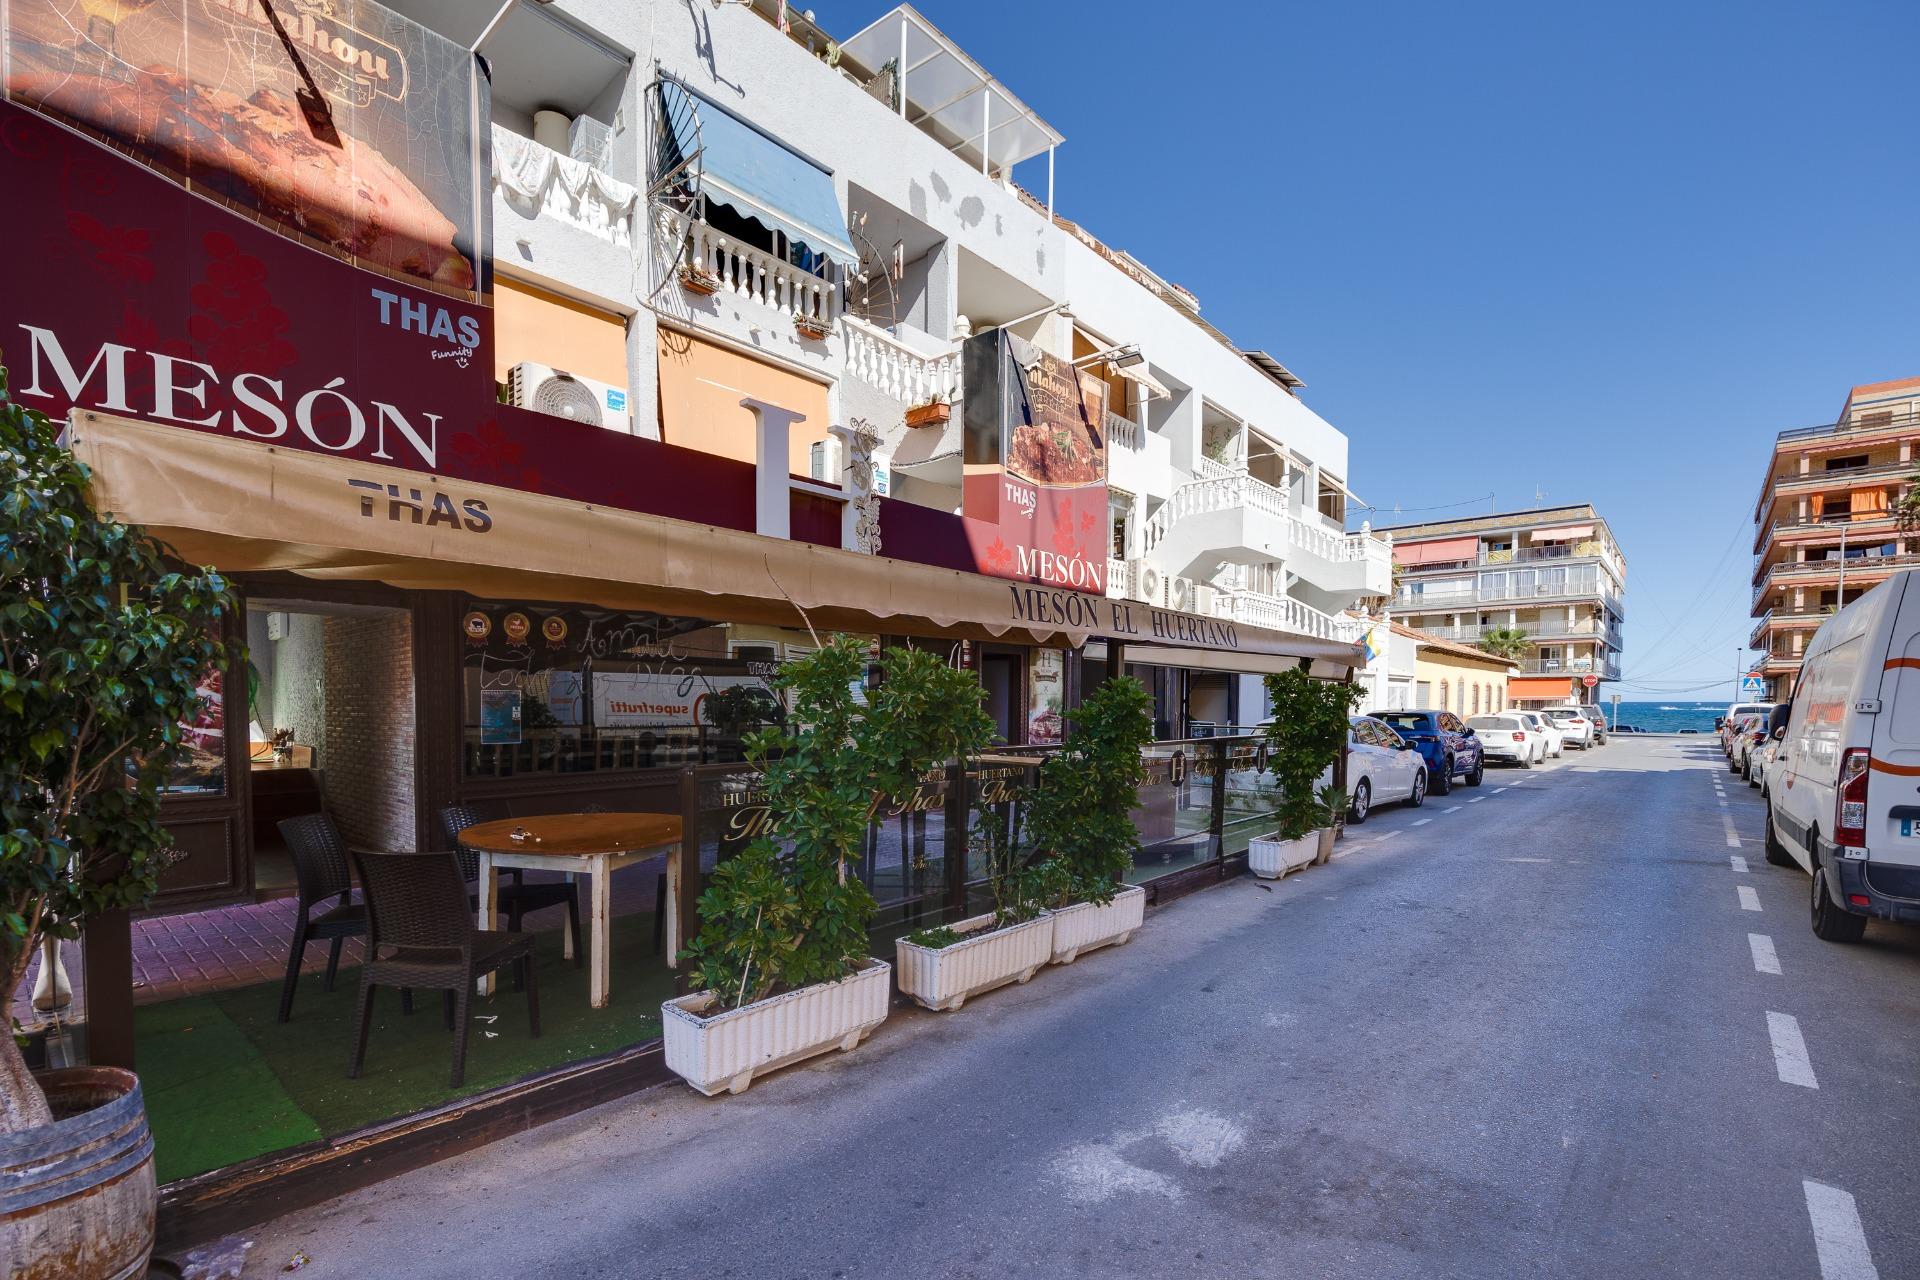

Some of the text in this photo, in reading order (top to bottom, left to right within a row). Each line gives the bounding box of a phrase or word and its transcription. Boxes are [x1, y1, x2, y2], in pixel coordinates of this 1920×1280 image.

[371, 288, 480, 348] THAS
[431, 347, 473, 360] Funnity
[18, 323, 443, 469] MESÓN
[347, 478, 493, 533] THAS
[1004, 483, 1037, 508] THAS
[1016, 545, 1102, 590] MESÓN
[1008, 585, 1239, 648] MESÓN EL HUERTANO
[978, 767, 1024, 780] HUERTANO
[723, 805, 784, 842] Tha
